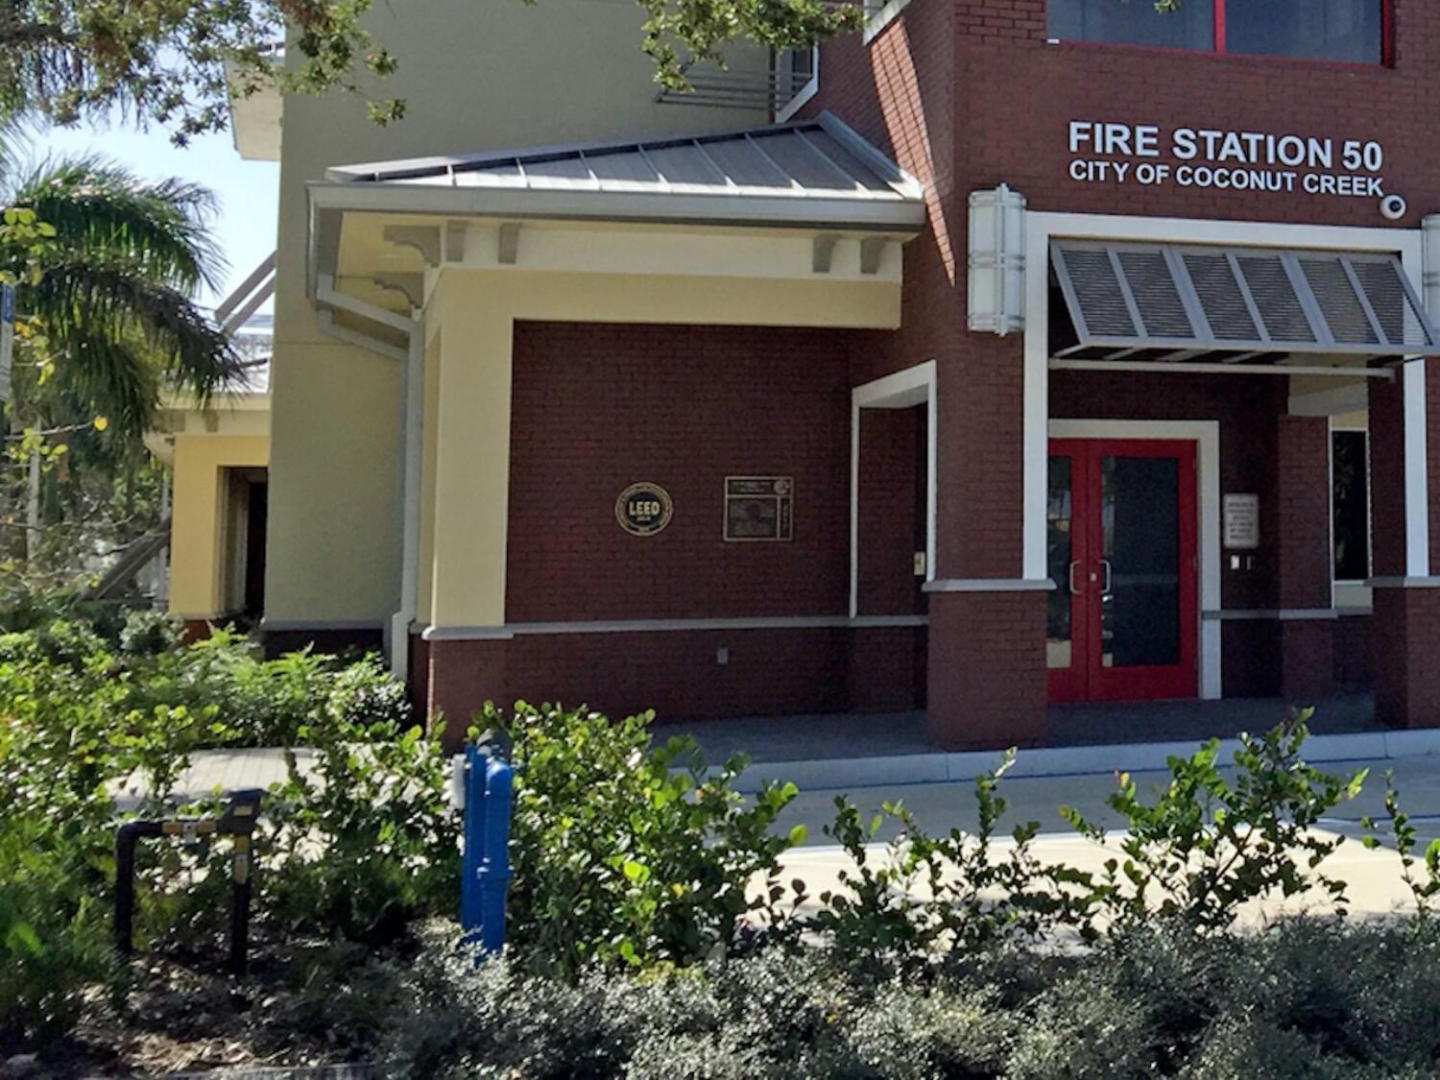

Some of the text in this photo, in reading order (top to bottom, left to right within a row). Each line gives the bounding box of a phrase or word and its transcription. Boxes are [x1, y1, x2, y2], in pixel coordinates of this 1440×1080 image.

[1068, 121, 1384, 172] FIRE STATION 50
[1069, 160, 1384, 197] CITY OF COCONUT CREEK
[629, 501, 660, 516] LEED
